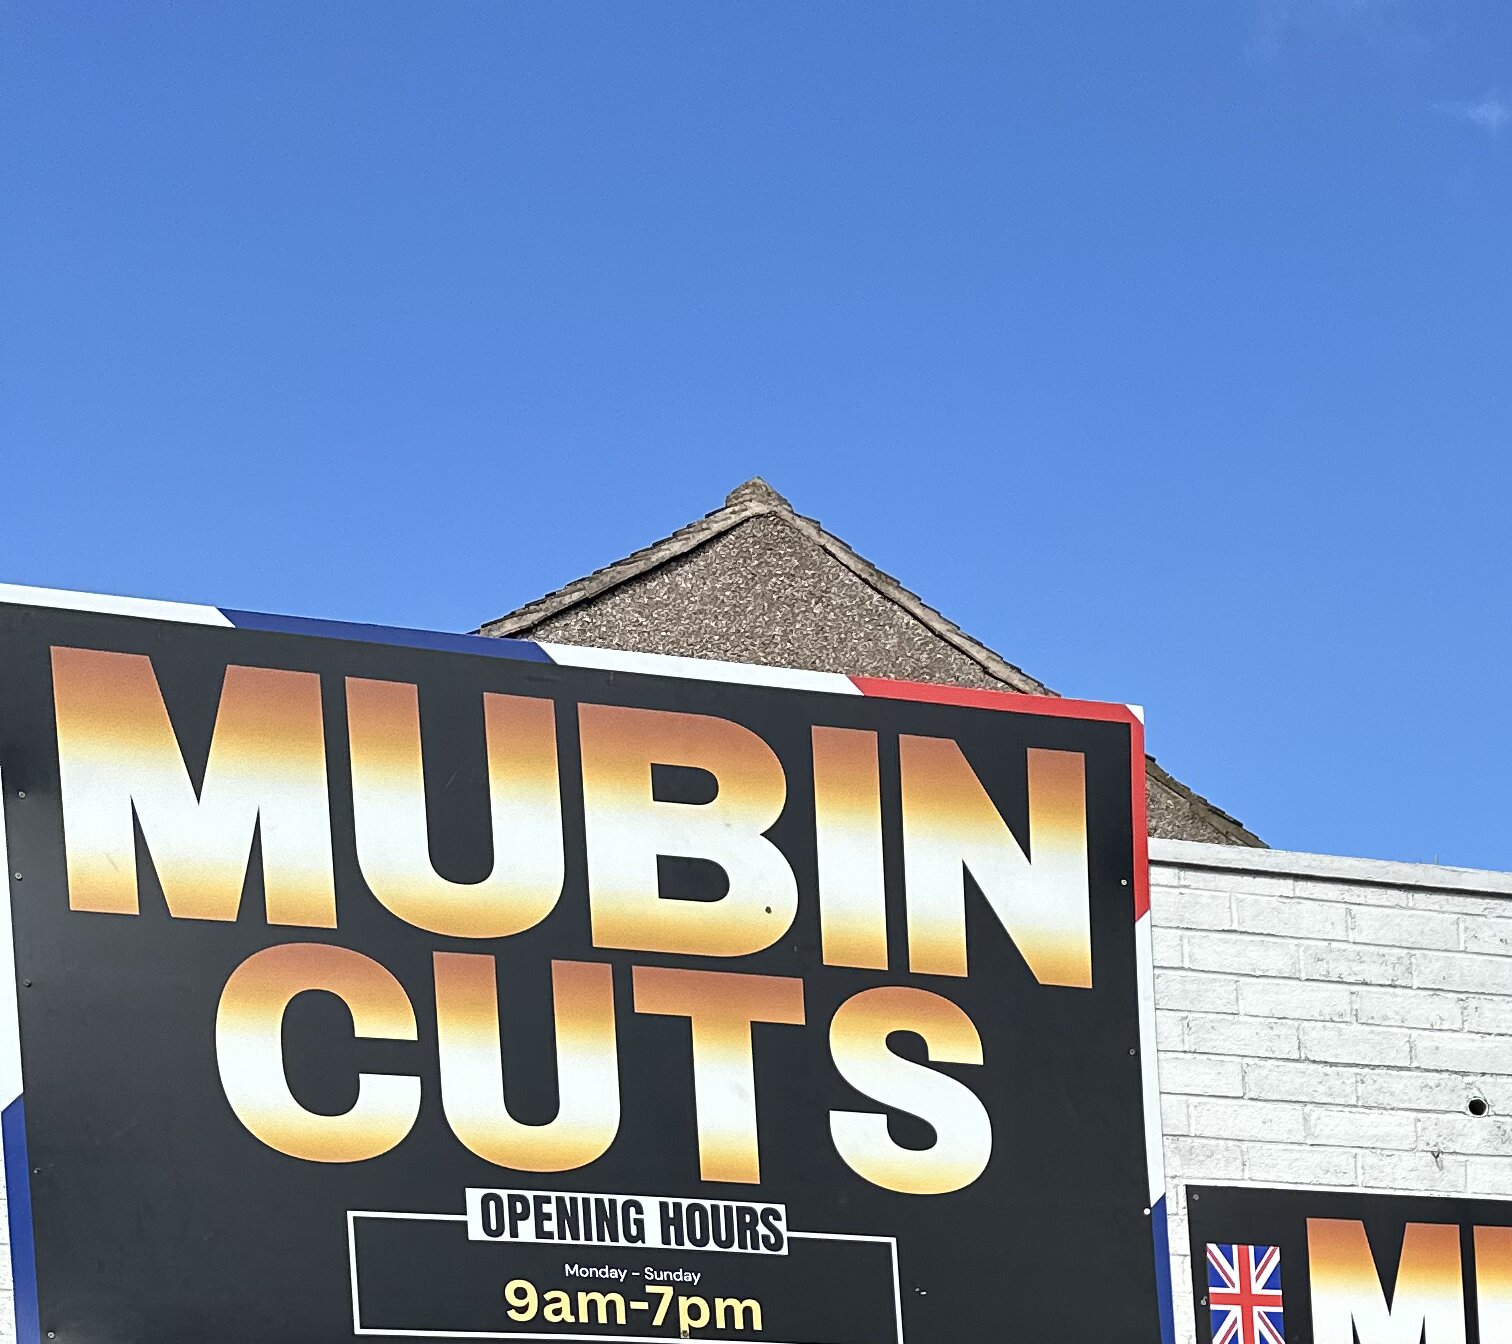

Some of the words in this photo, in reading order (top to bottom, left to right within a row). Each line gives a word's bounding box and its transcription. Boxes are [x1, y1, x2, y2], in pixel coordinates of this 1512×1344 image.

[50, 646, 1094, 988] MUBIN
[215, 942, 993, 1195] CUTS
[480, 1192, 645, 1245] OPENING
[660, 1200, 785, 1253] HOURS
[564, 1262, 627, 1283] Monday
[644, 1266, 701, 1286] Sunday
[504, 1278, 764, 1340] 9am-7pm
